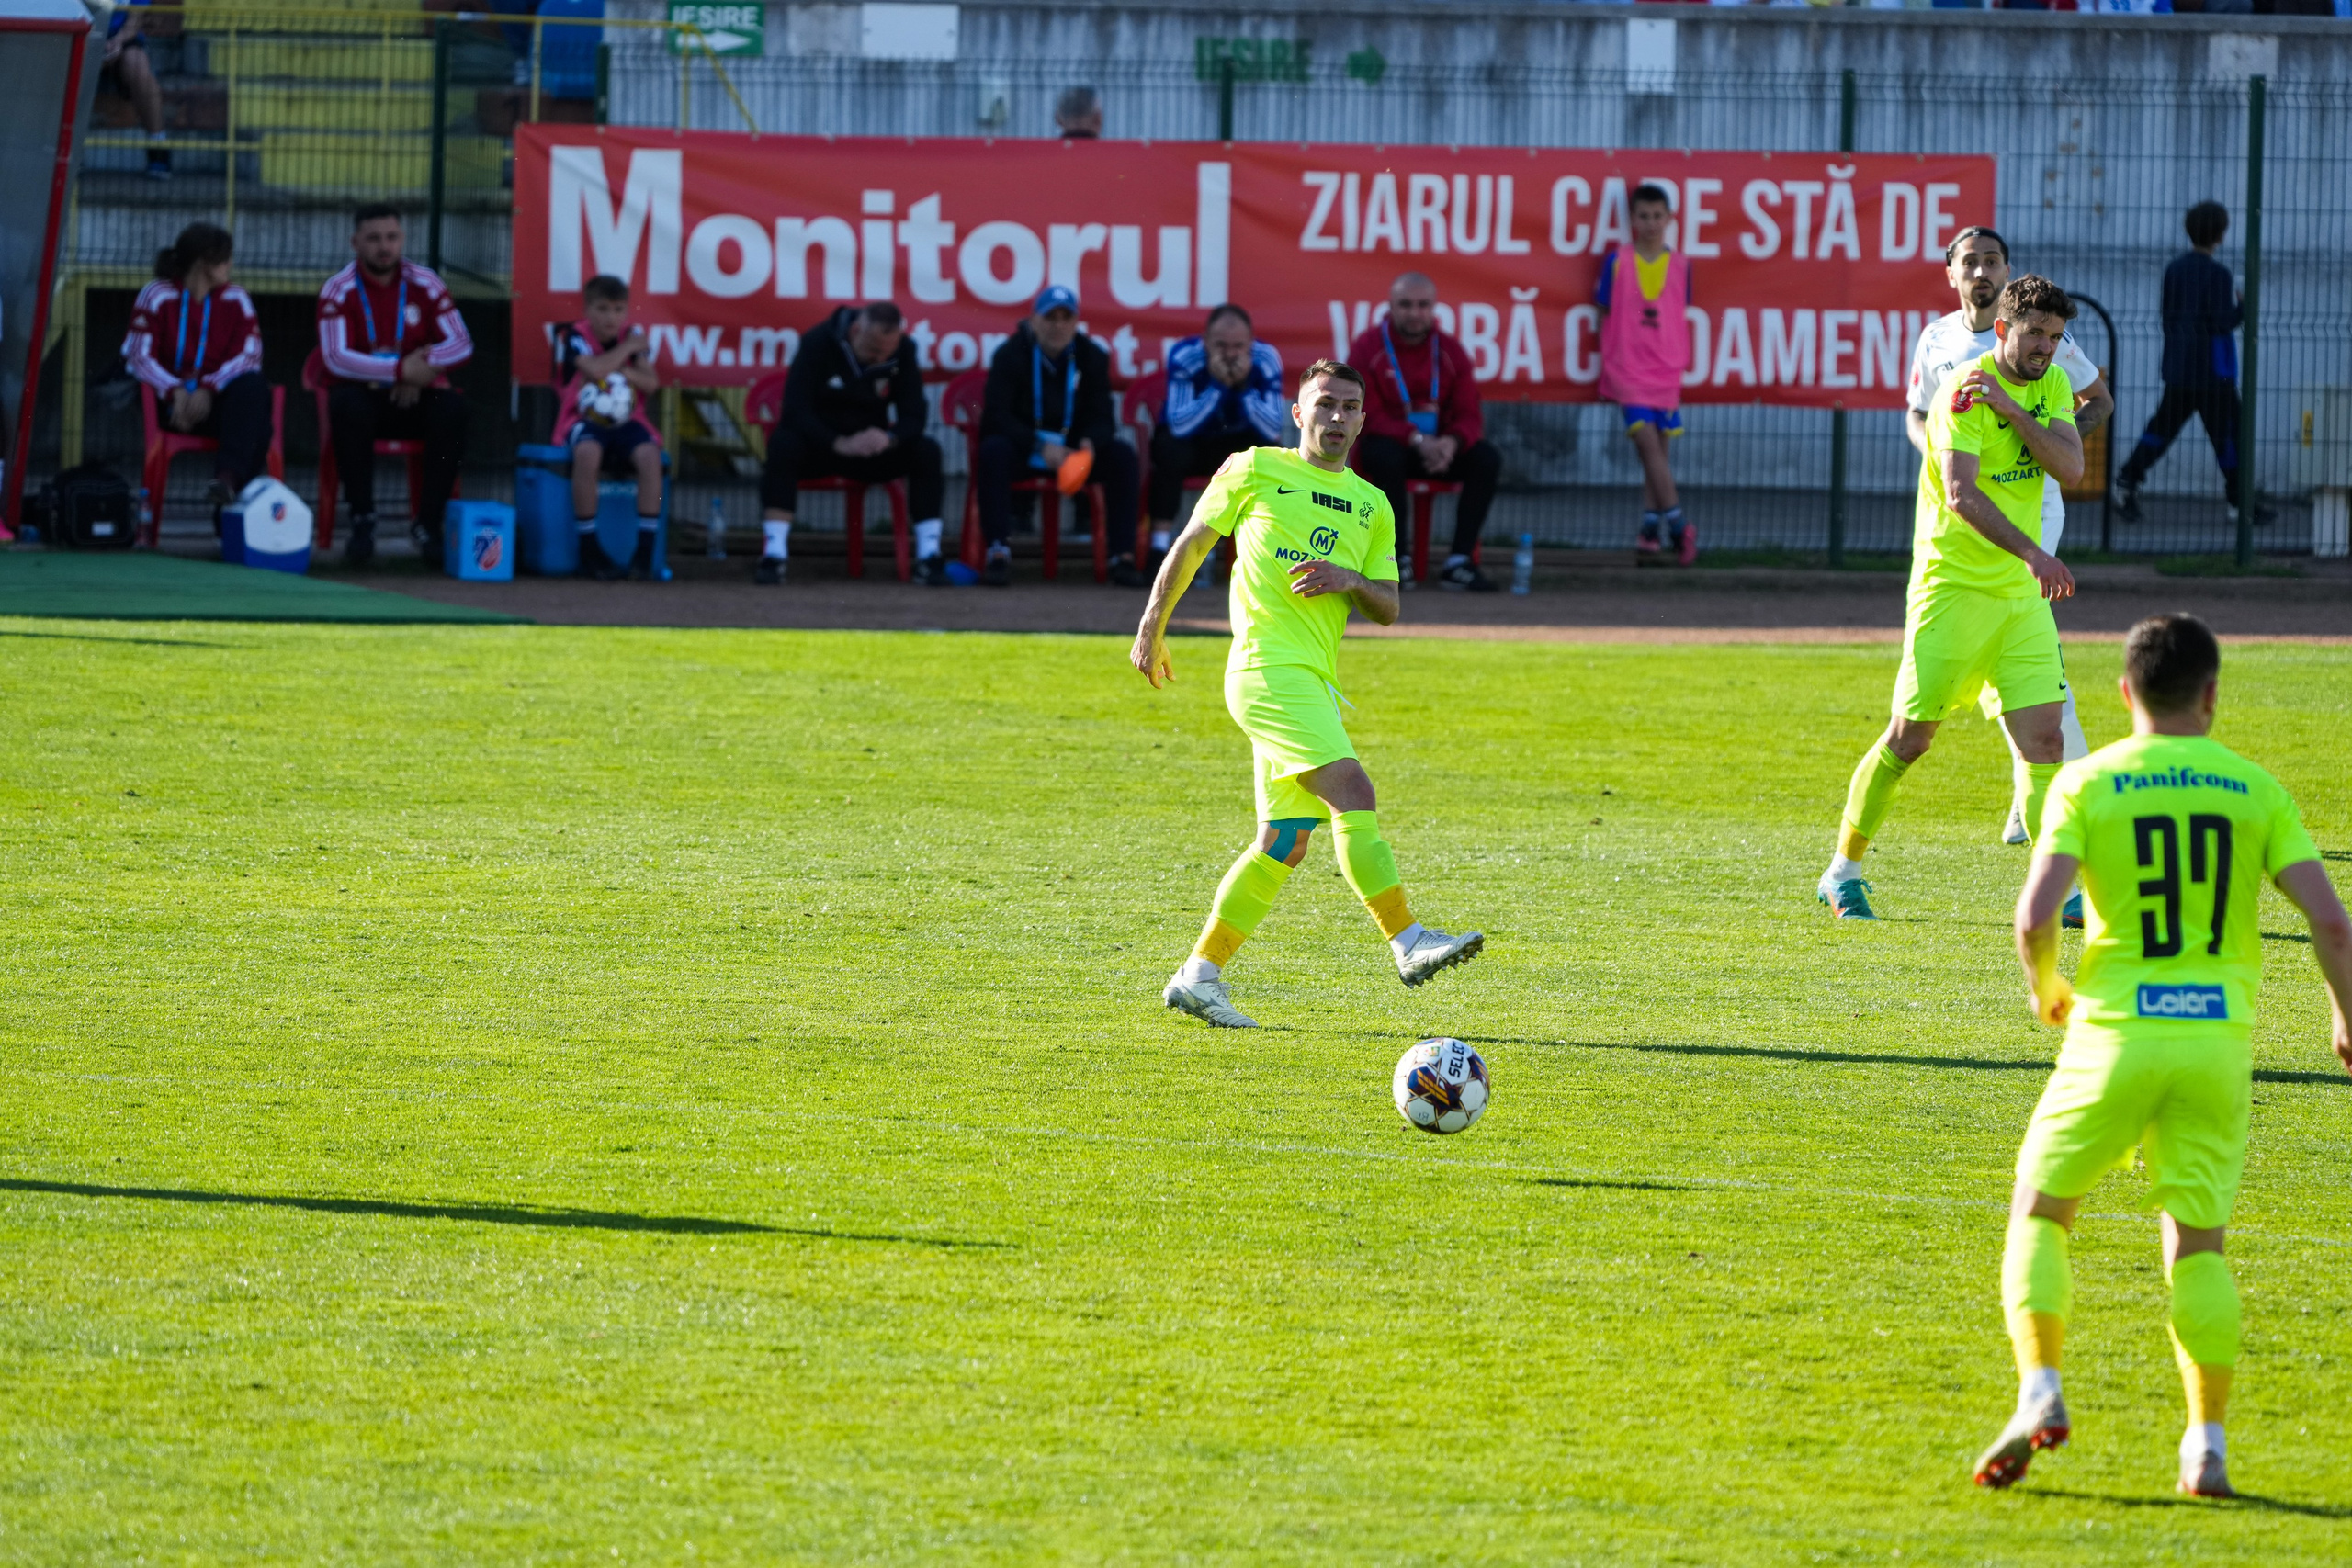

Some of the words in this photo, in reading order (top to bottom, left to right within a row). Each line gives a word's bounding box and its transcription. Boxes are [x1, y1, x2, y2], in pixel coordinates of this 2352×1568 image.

[548, 144, 1232, 310] Monitorul
[1298, 171, 1531, 256] ZIARUL
[1739, 164, 1861, 262] STĂ
[1880, 183, 1960, 263] DE
[1328, 287, 1545, 383] VBĂ
[1680, 305, 1941, 389] OAMENI
[1311, 491, 1352, 514] IASI
[1991, 466, 2041, 483] MOZZART
[2112, 766, 2249, 795] Panifcom
[2133, 813, 2233, 959] 37
[1448, 1040, 1465, 1078] SELEC
